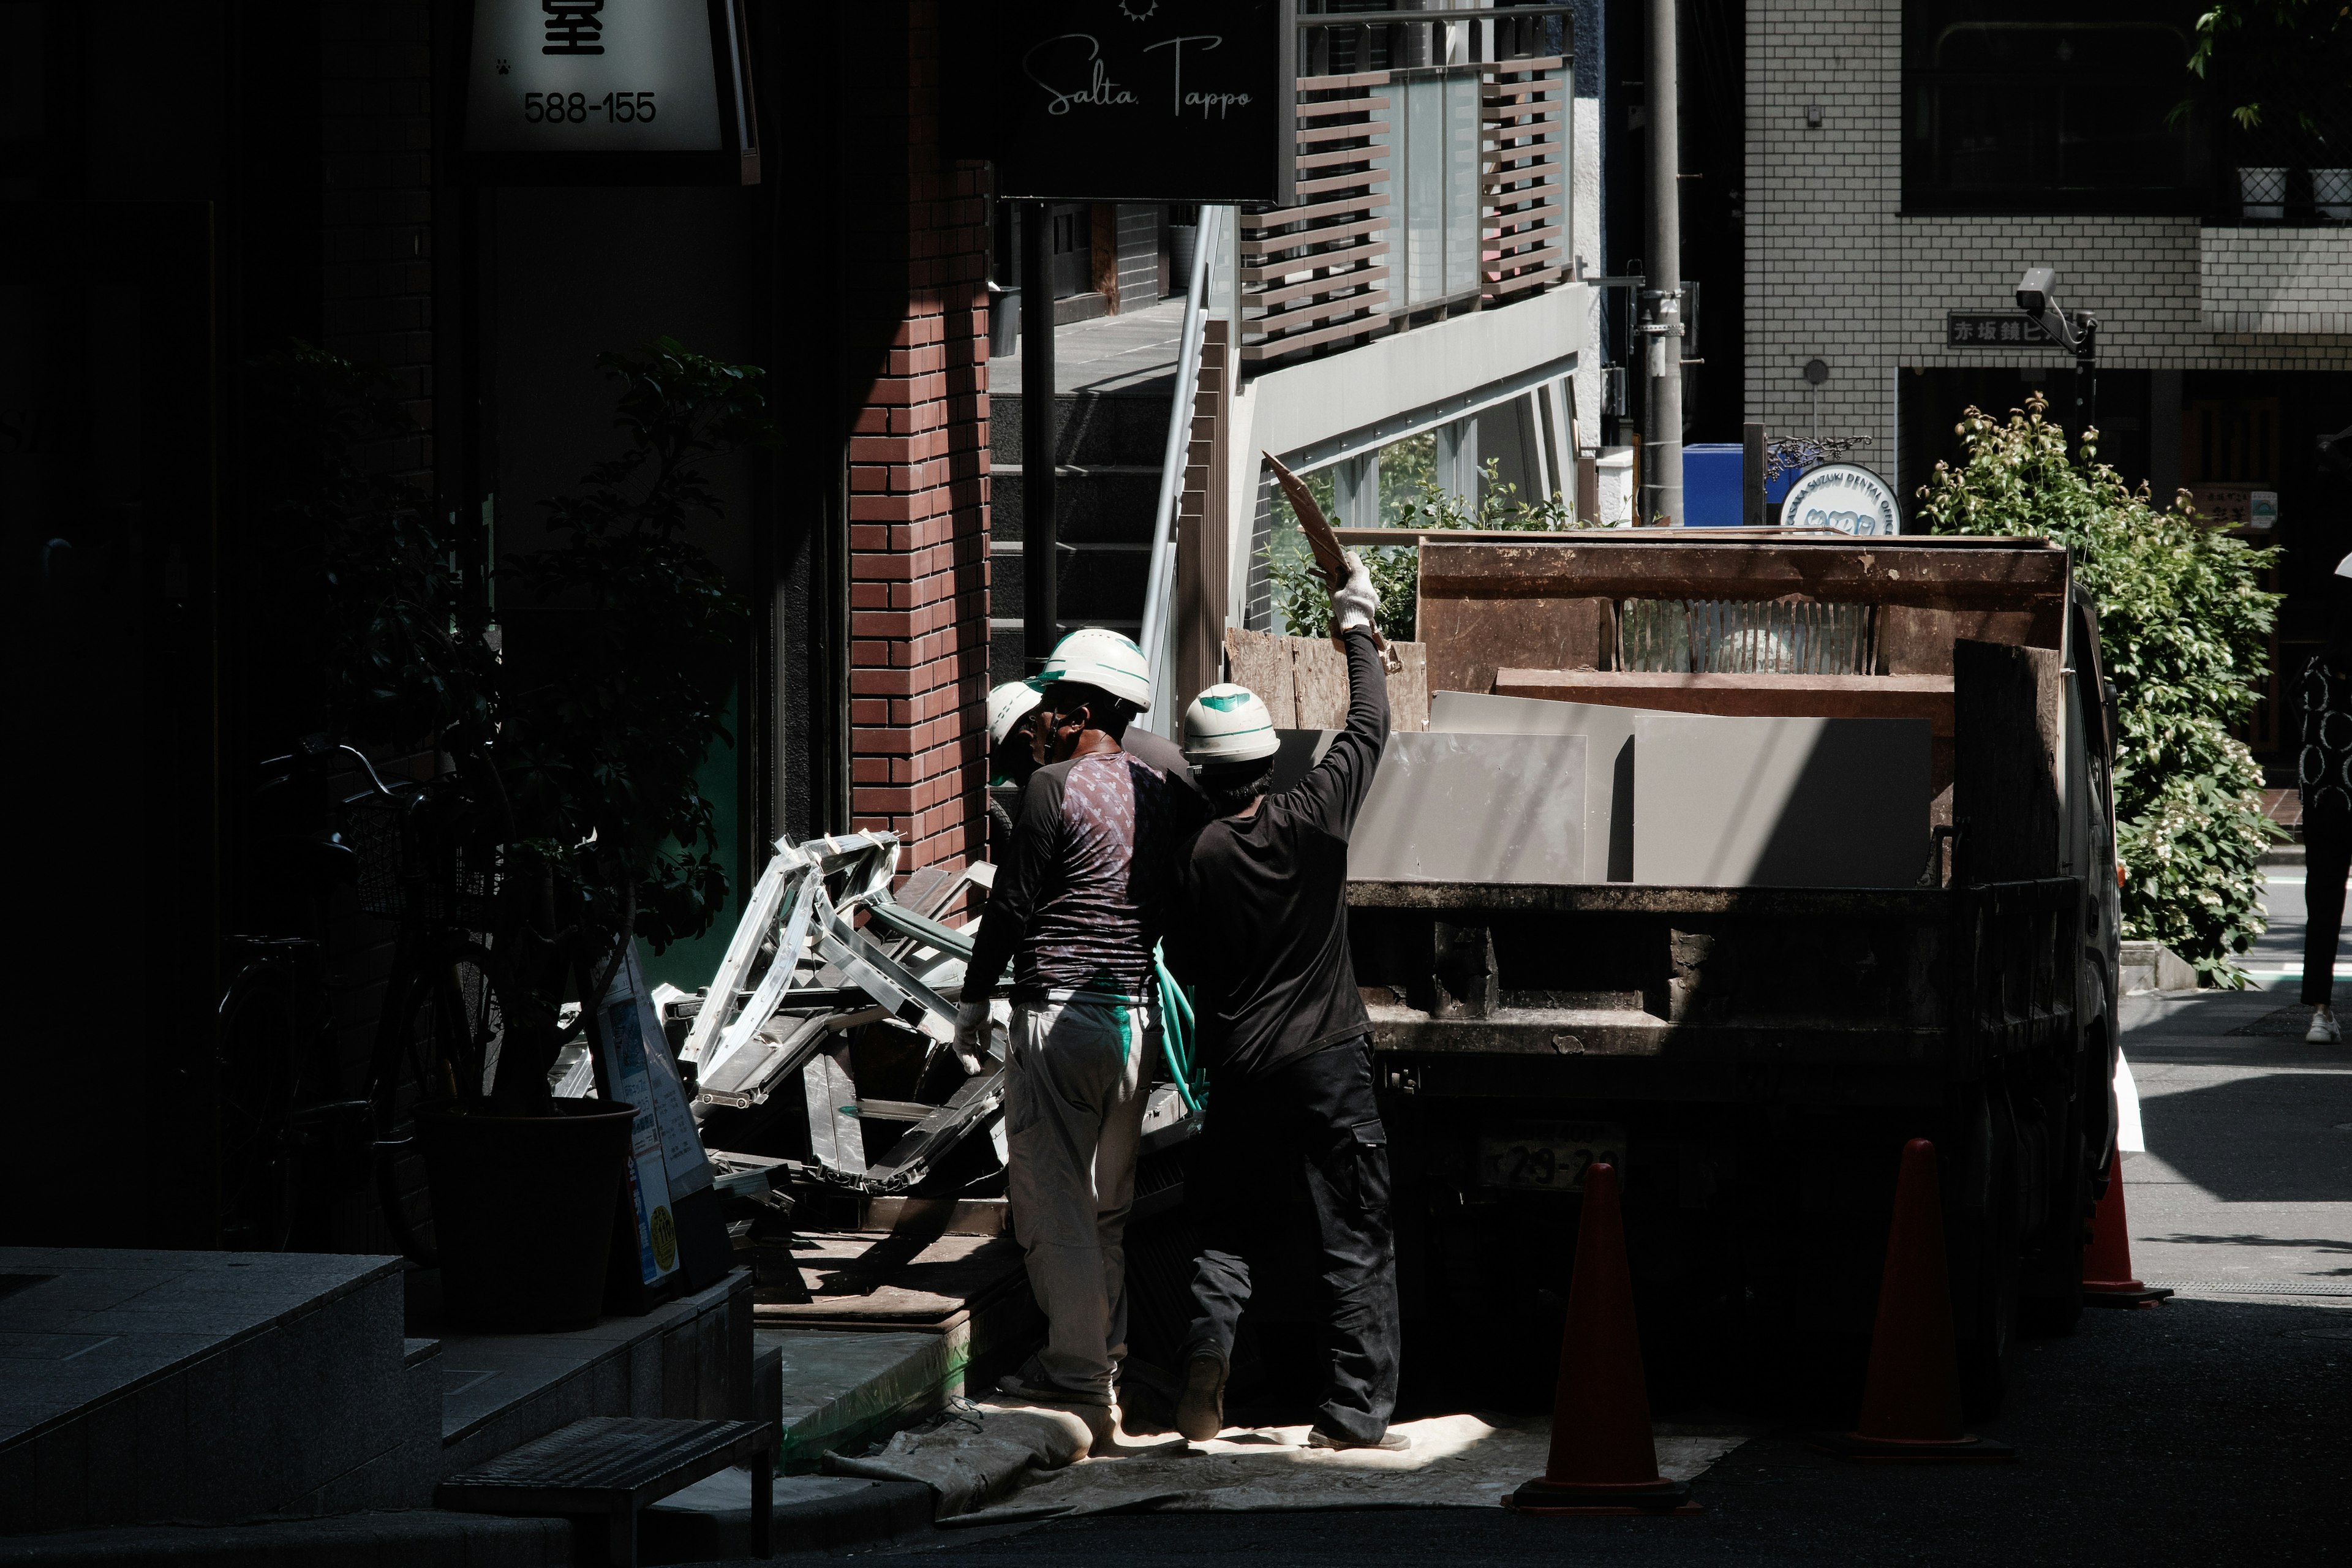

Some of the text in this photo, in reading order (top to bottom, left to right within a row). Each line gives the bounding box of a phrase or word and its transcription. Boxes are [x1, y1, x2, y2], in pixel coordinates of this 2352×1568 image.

[1143, 35, 1253, 120] Tappo
[524, 92, 657, 124] 588-155
[1954, 320, 2052, 341] 赤坂鏡ビ
[1808, 472, 1844, 488] SUZUKI
[1847, 473, 1882, 500] DENTAL
